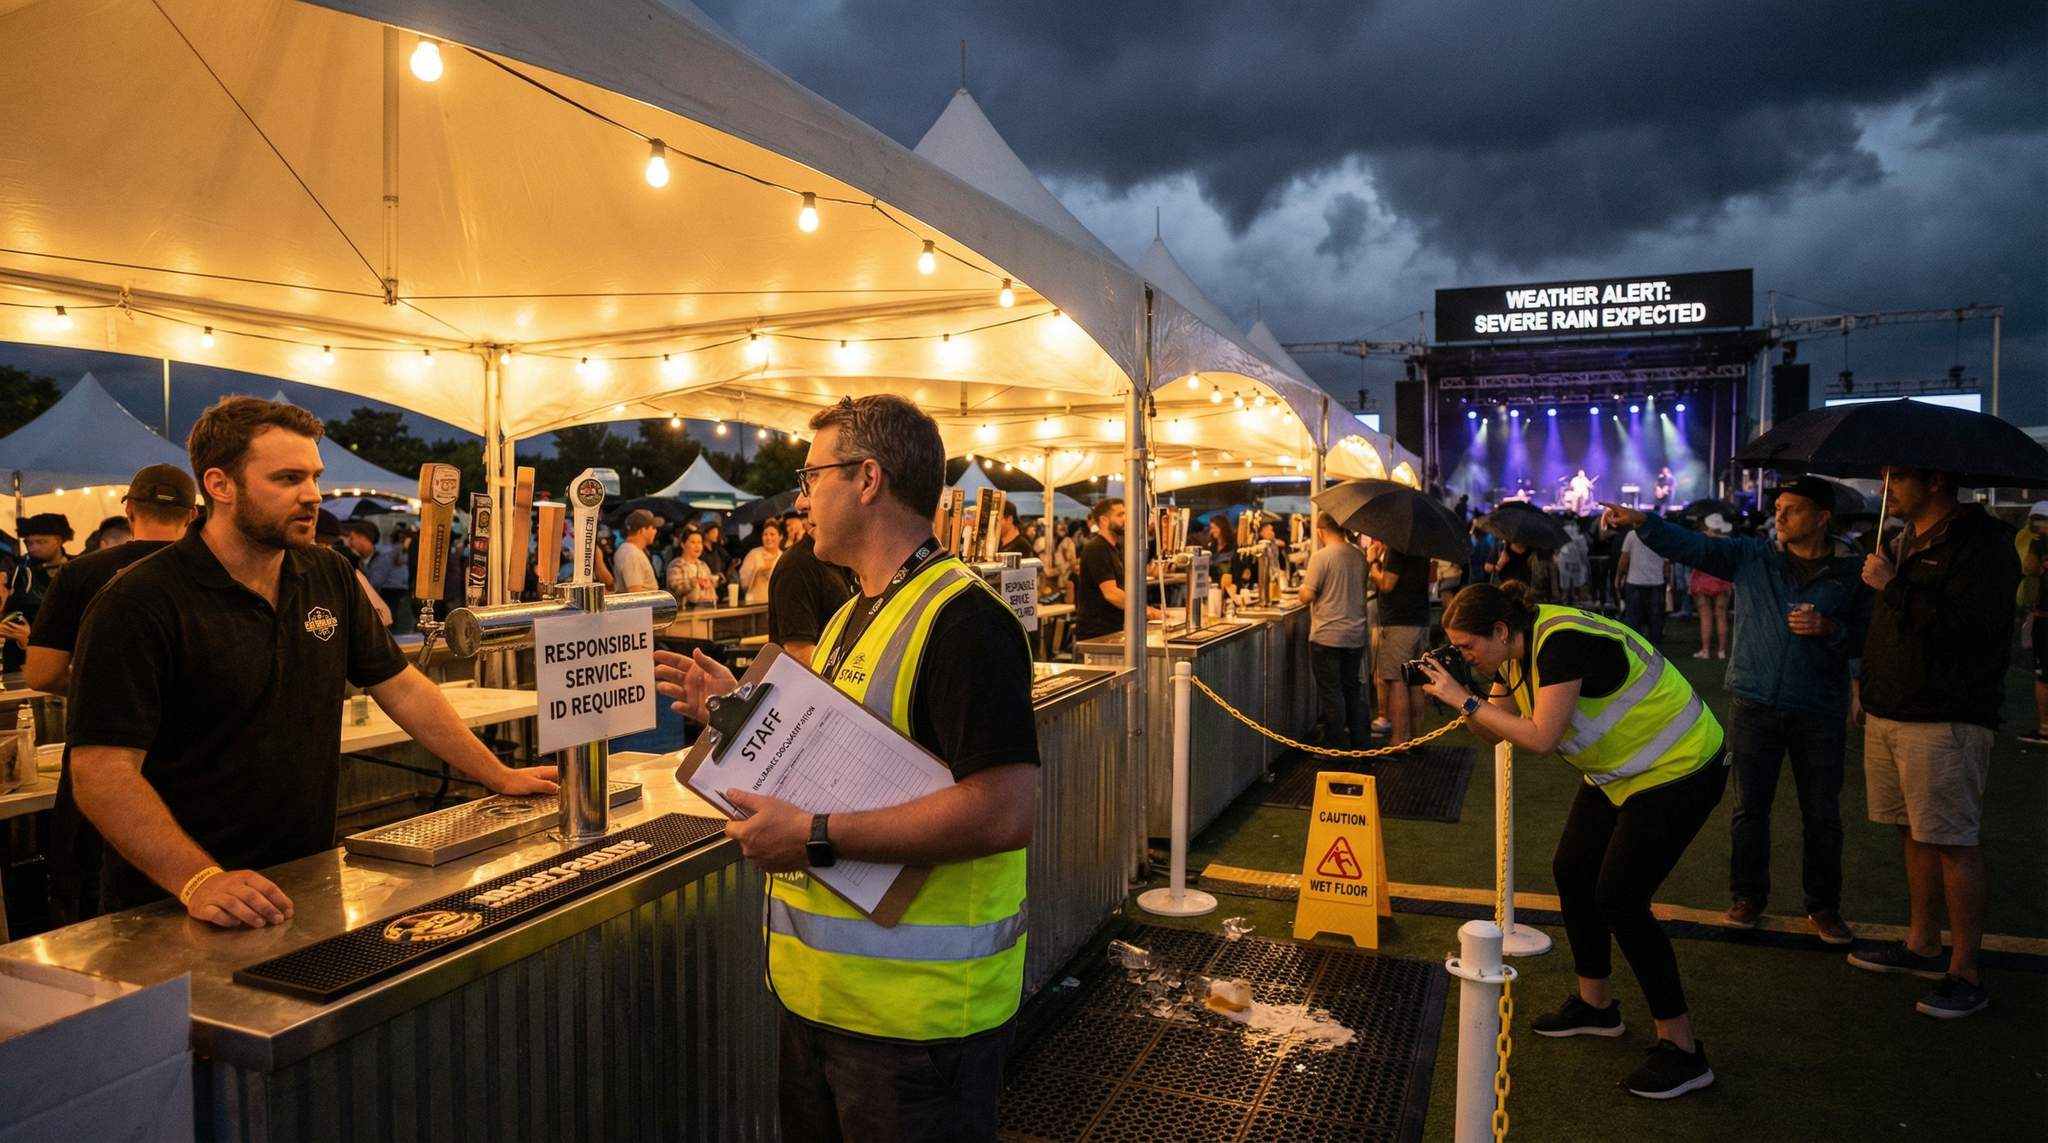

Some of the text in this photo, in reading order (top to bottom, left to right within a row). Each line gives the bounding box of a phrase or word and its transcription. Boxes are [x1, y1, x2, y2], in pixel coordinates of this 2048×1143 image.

[1505, 281, 1671, 309] WEATHER ALERT:
[1474, 302, 1706, 333] SEVERE RAIN EXPECTED
[544, 632, 647, 664] RESPONSIBLE
[565, 661, 632, 689] SERVICE:
[839, 669, 865, 684] STAFF
[550, 685, 645, 720] ID REQUIRED
[741, 707, 782, 762] STAFF
[1310, 879, 1368, 897] WET FLOOR
